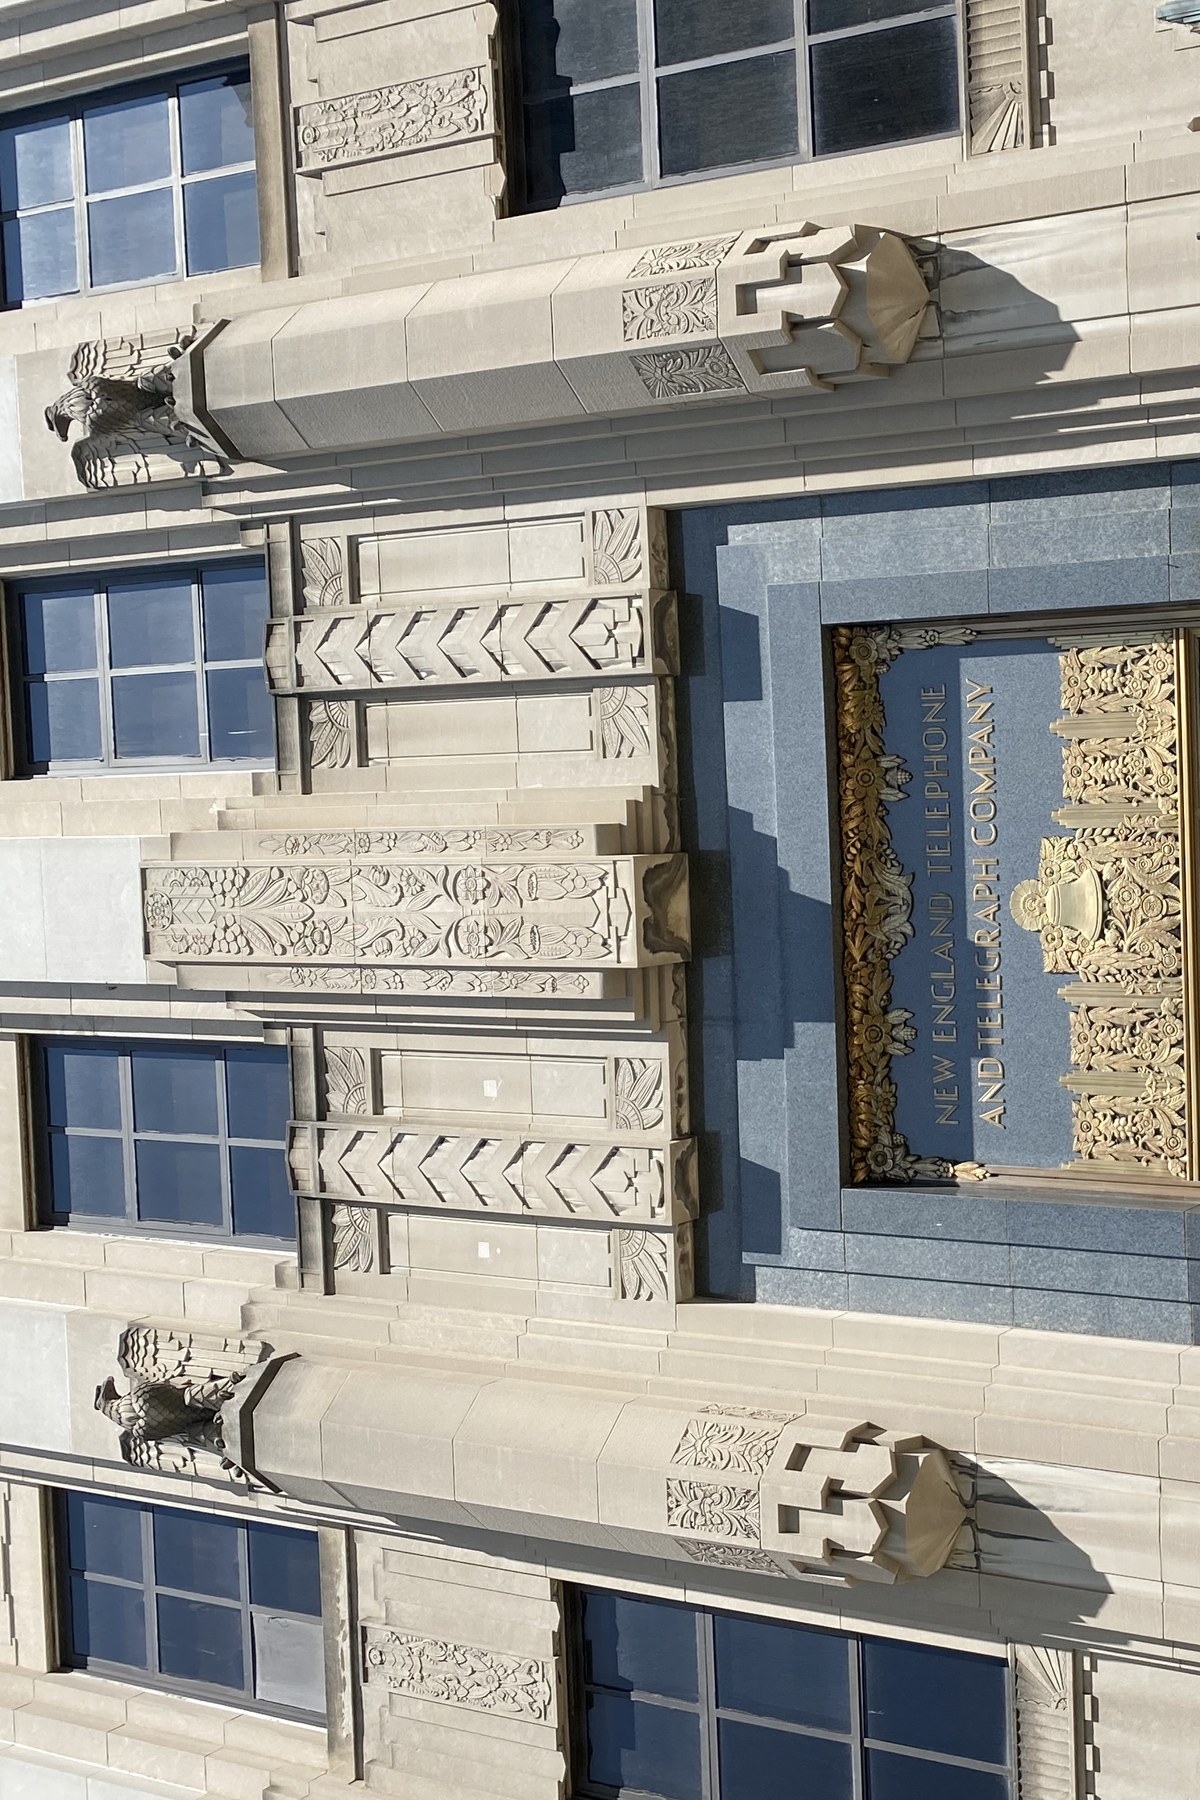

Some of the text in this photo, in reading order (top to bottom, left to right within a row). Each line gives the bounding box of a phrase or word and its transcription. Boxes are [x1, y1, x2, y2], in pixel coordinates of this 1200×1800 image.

[920, 683, 960, 1126] NEW ENGLAND TELEPHONE
[964, 678, 1006, 1131] AND TELEGRAPH COMPANY
